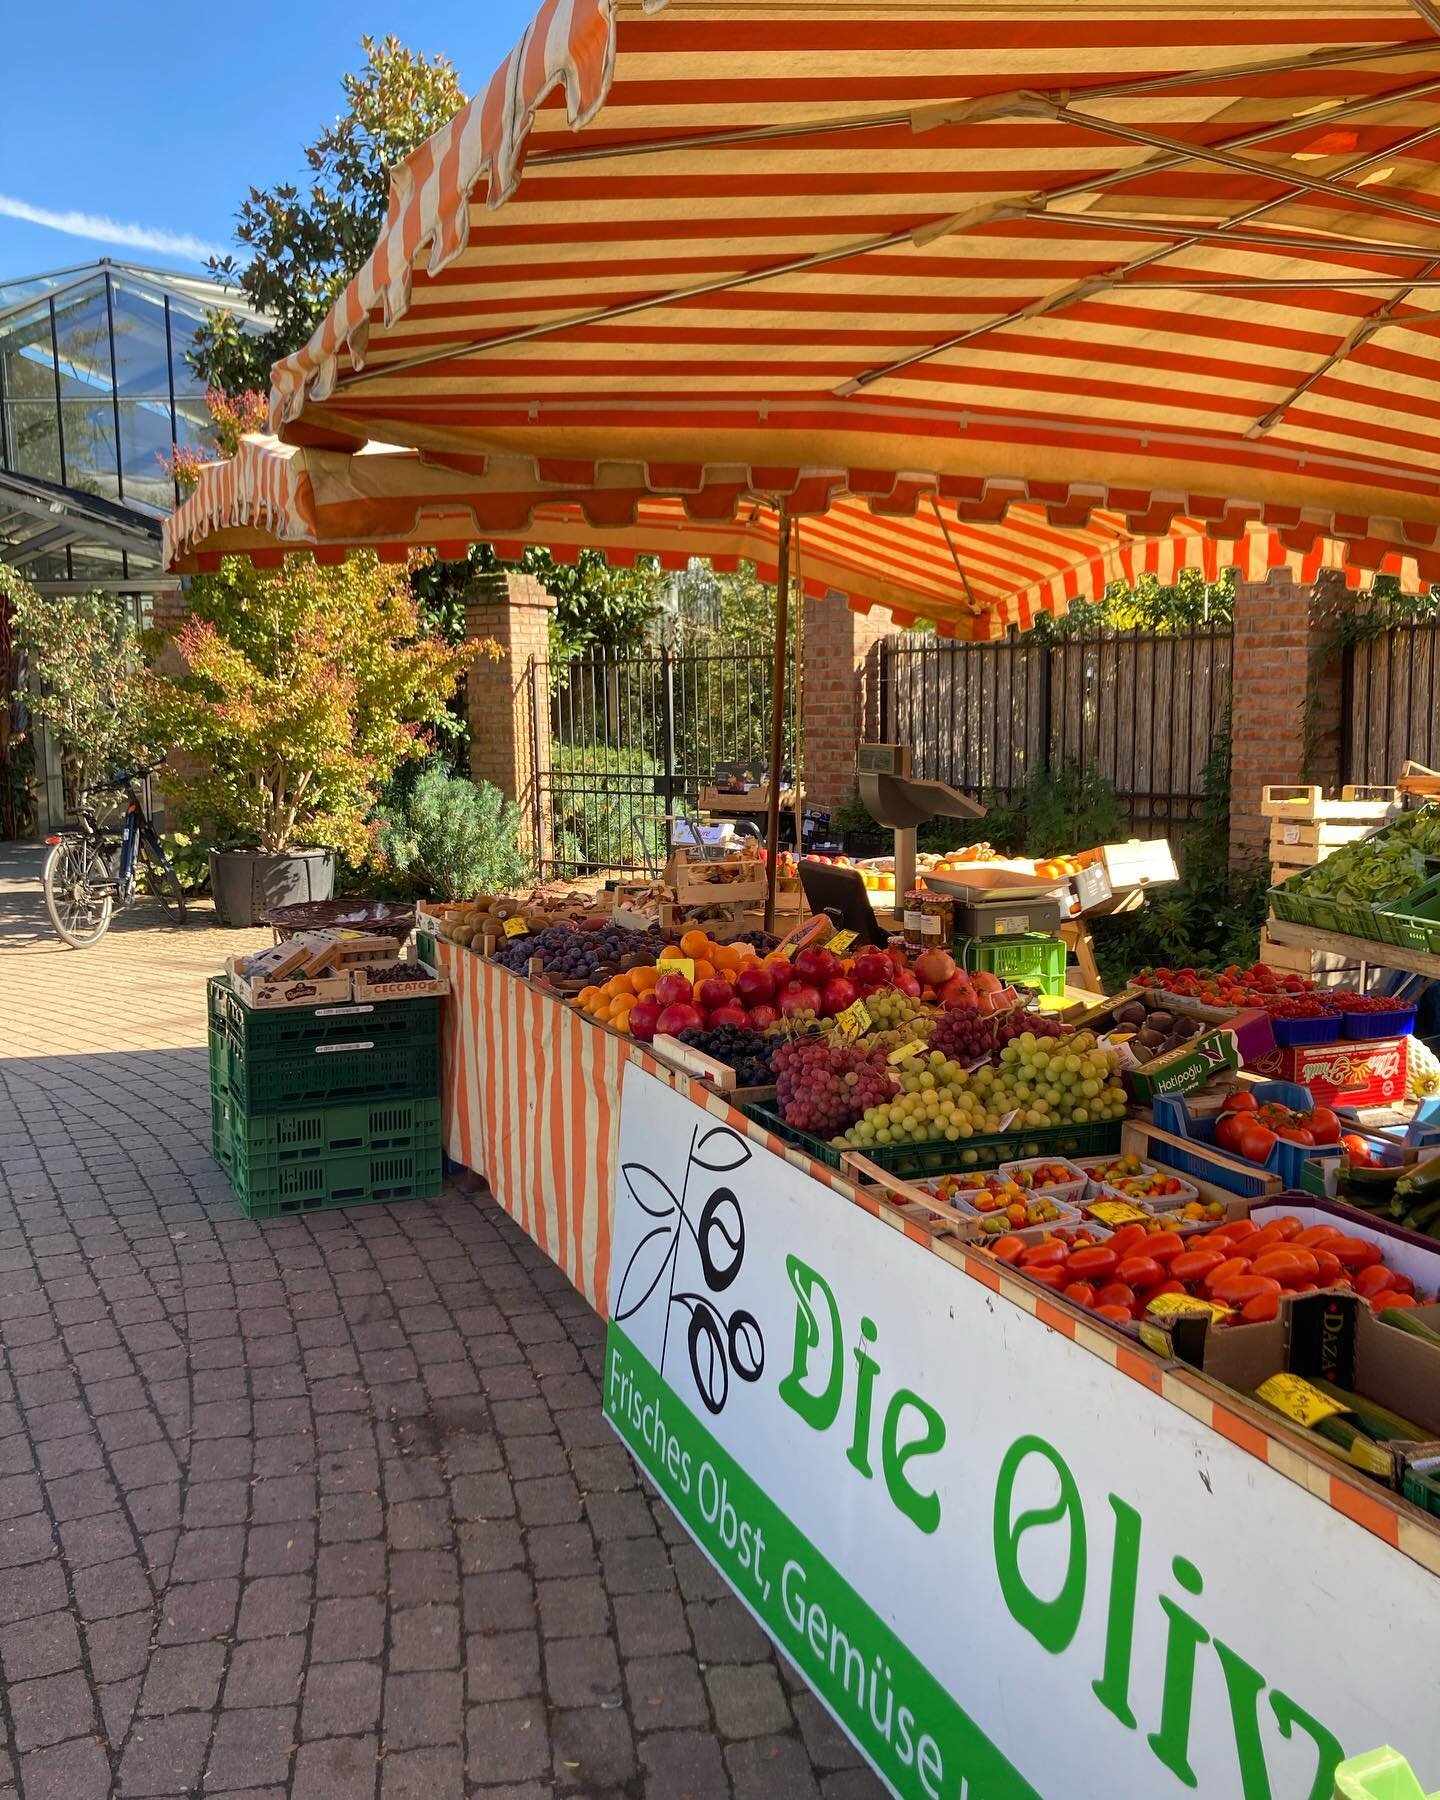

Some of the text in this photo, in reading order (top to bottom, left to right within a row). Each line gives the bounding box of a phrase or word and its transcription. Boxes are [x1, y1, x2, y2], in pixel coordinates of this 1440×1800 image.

[374, 982, 427, 993] CECCATO
[778, 1253, 946, 1534] Die
[611, 1348, 943, 1800] Frisches Obst, Gemüse
